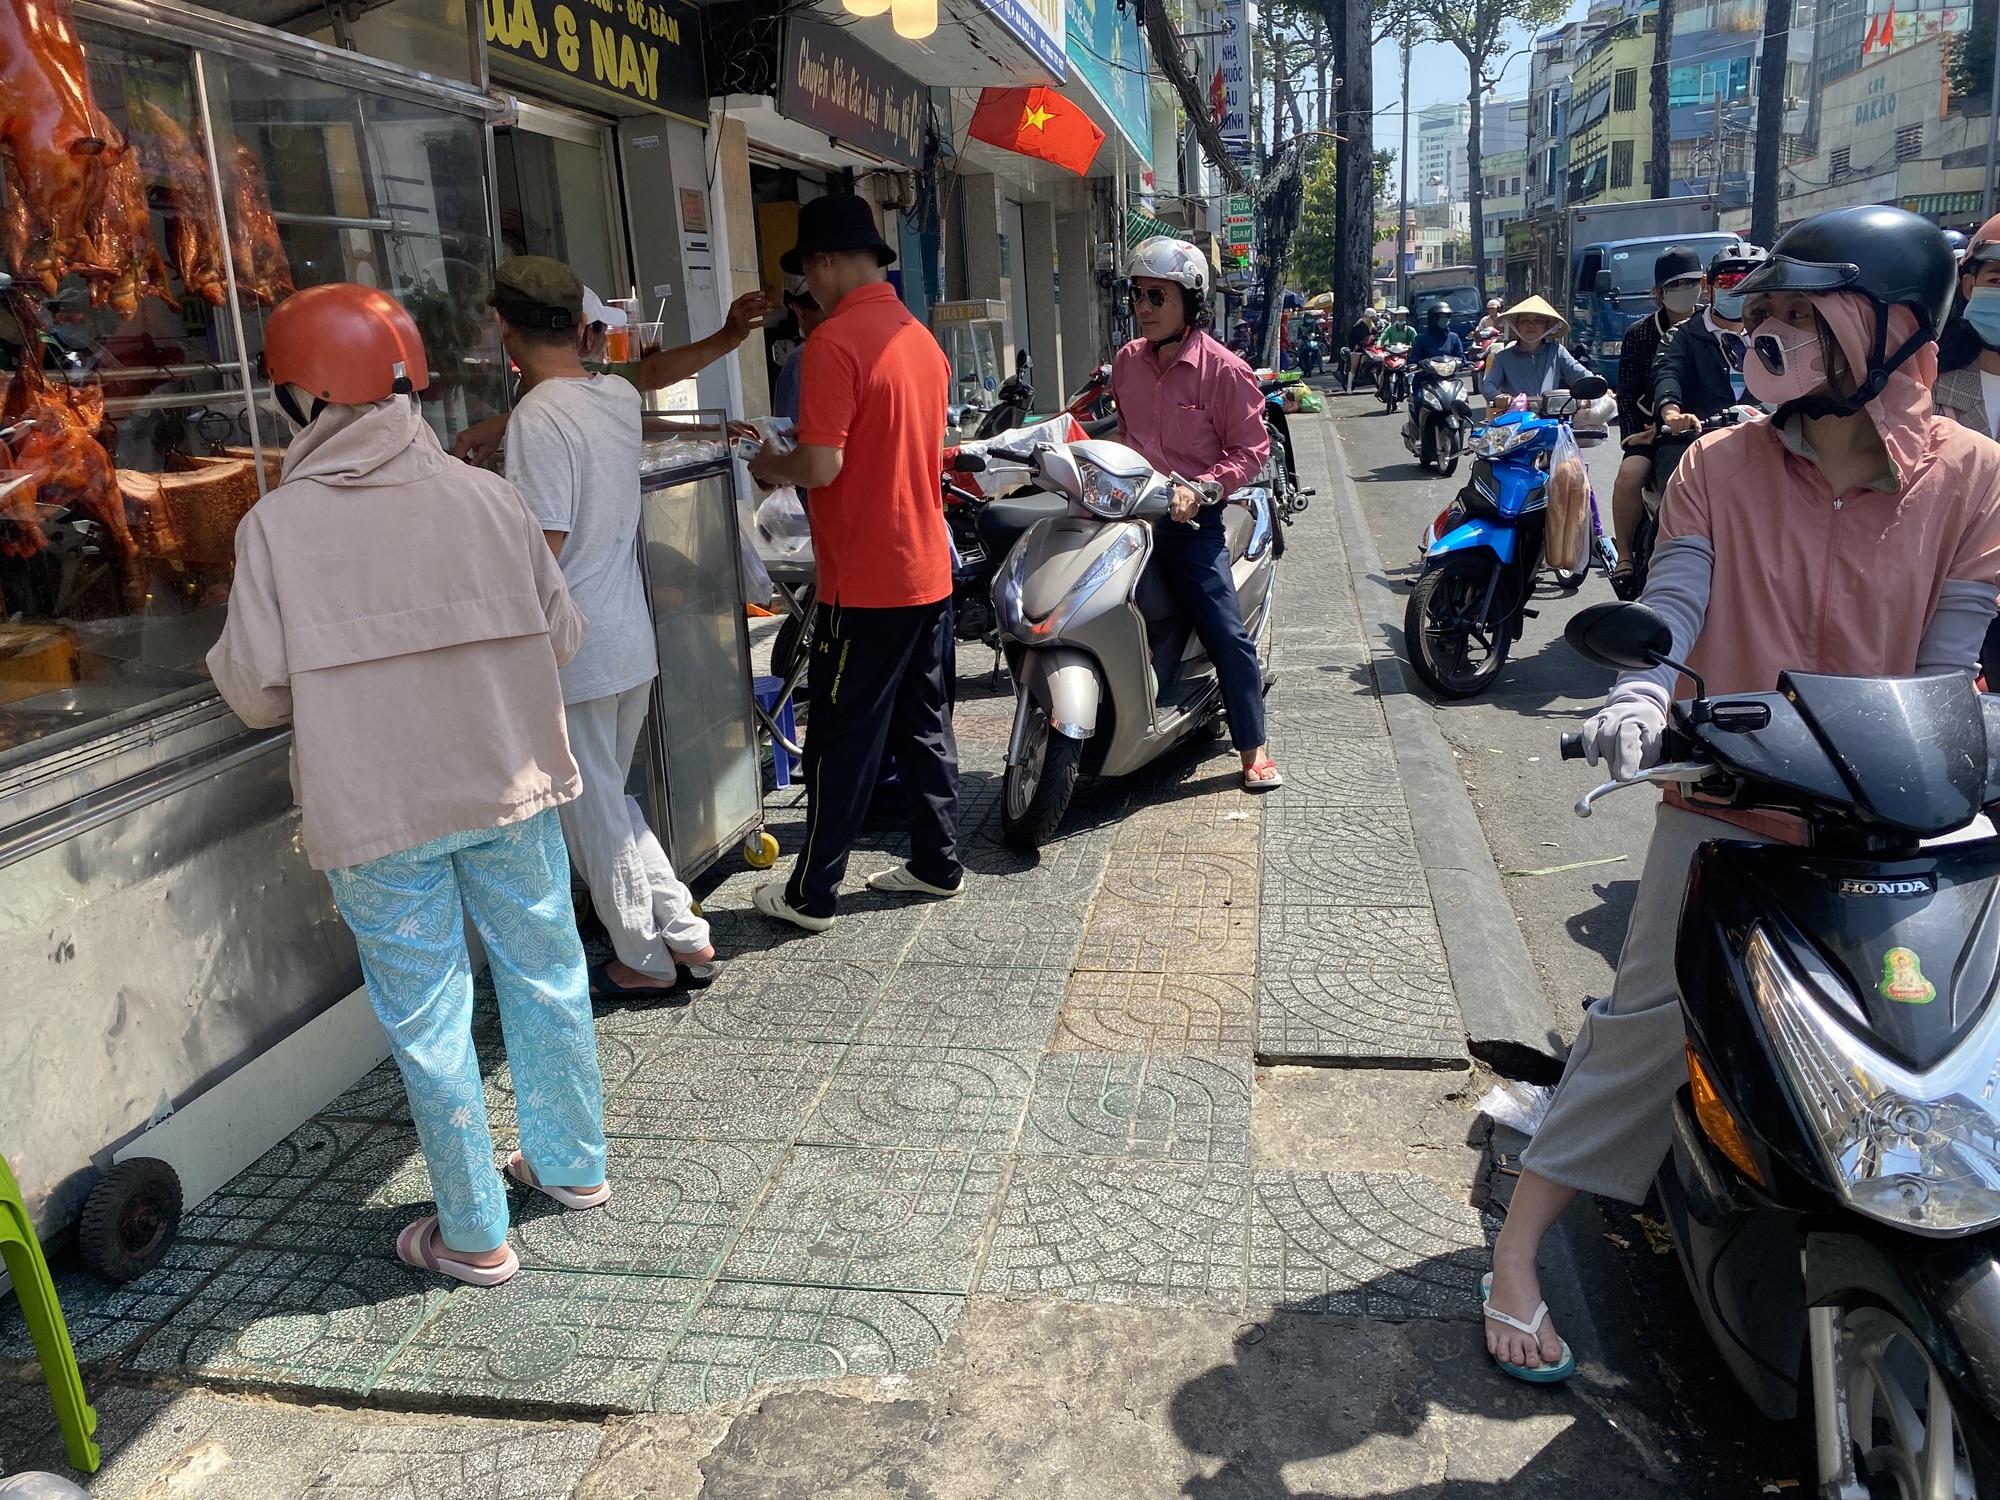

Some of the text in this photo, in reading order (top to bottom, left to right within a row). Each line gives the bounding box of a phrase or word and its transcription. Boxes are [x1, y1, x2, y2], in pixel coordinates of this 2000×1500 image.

[649, 4, 680, 46] BÀN
[553, 5, 581, 72] &
[589, 19, 659, 101] NAY
[1222, 41, 1238, 61] NHÀ
[1223, 61, 1243, 83] HUỐC
[798, 37, 829, 110] Chuyên
[831, 56, 846, 108] Sửa
[848, 66, 862, 116] Các
[864, 76, 880, 132] Loại
[1232, 228, 1251, 239] SIAM
[936, 304, 985, 320] THAY PIN
[1841, 880, 1930, 894] HONDA
